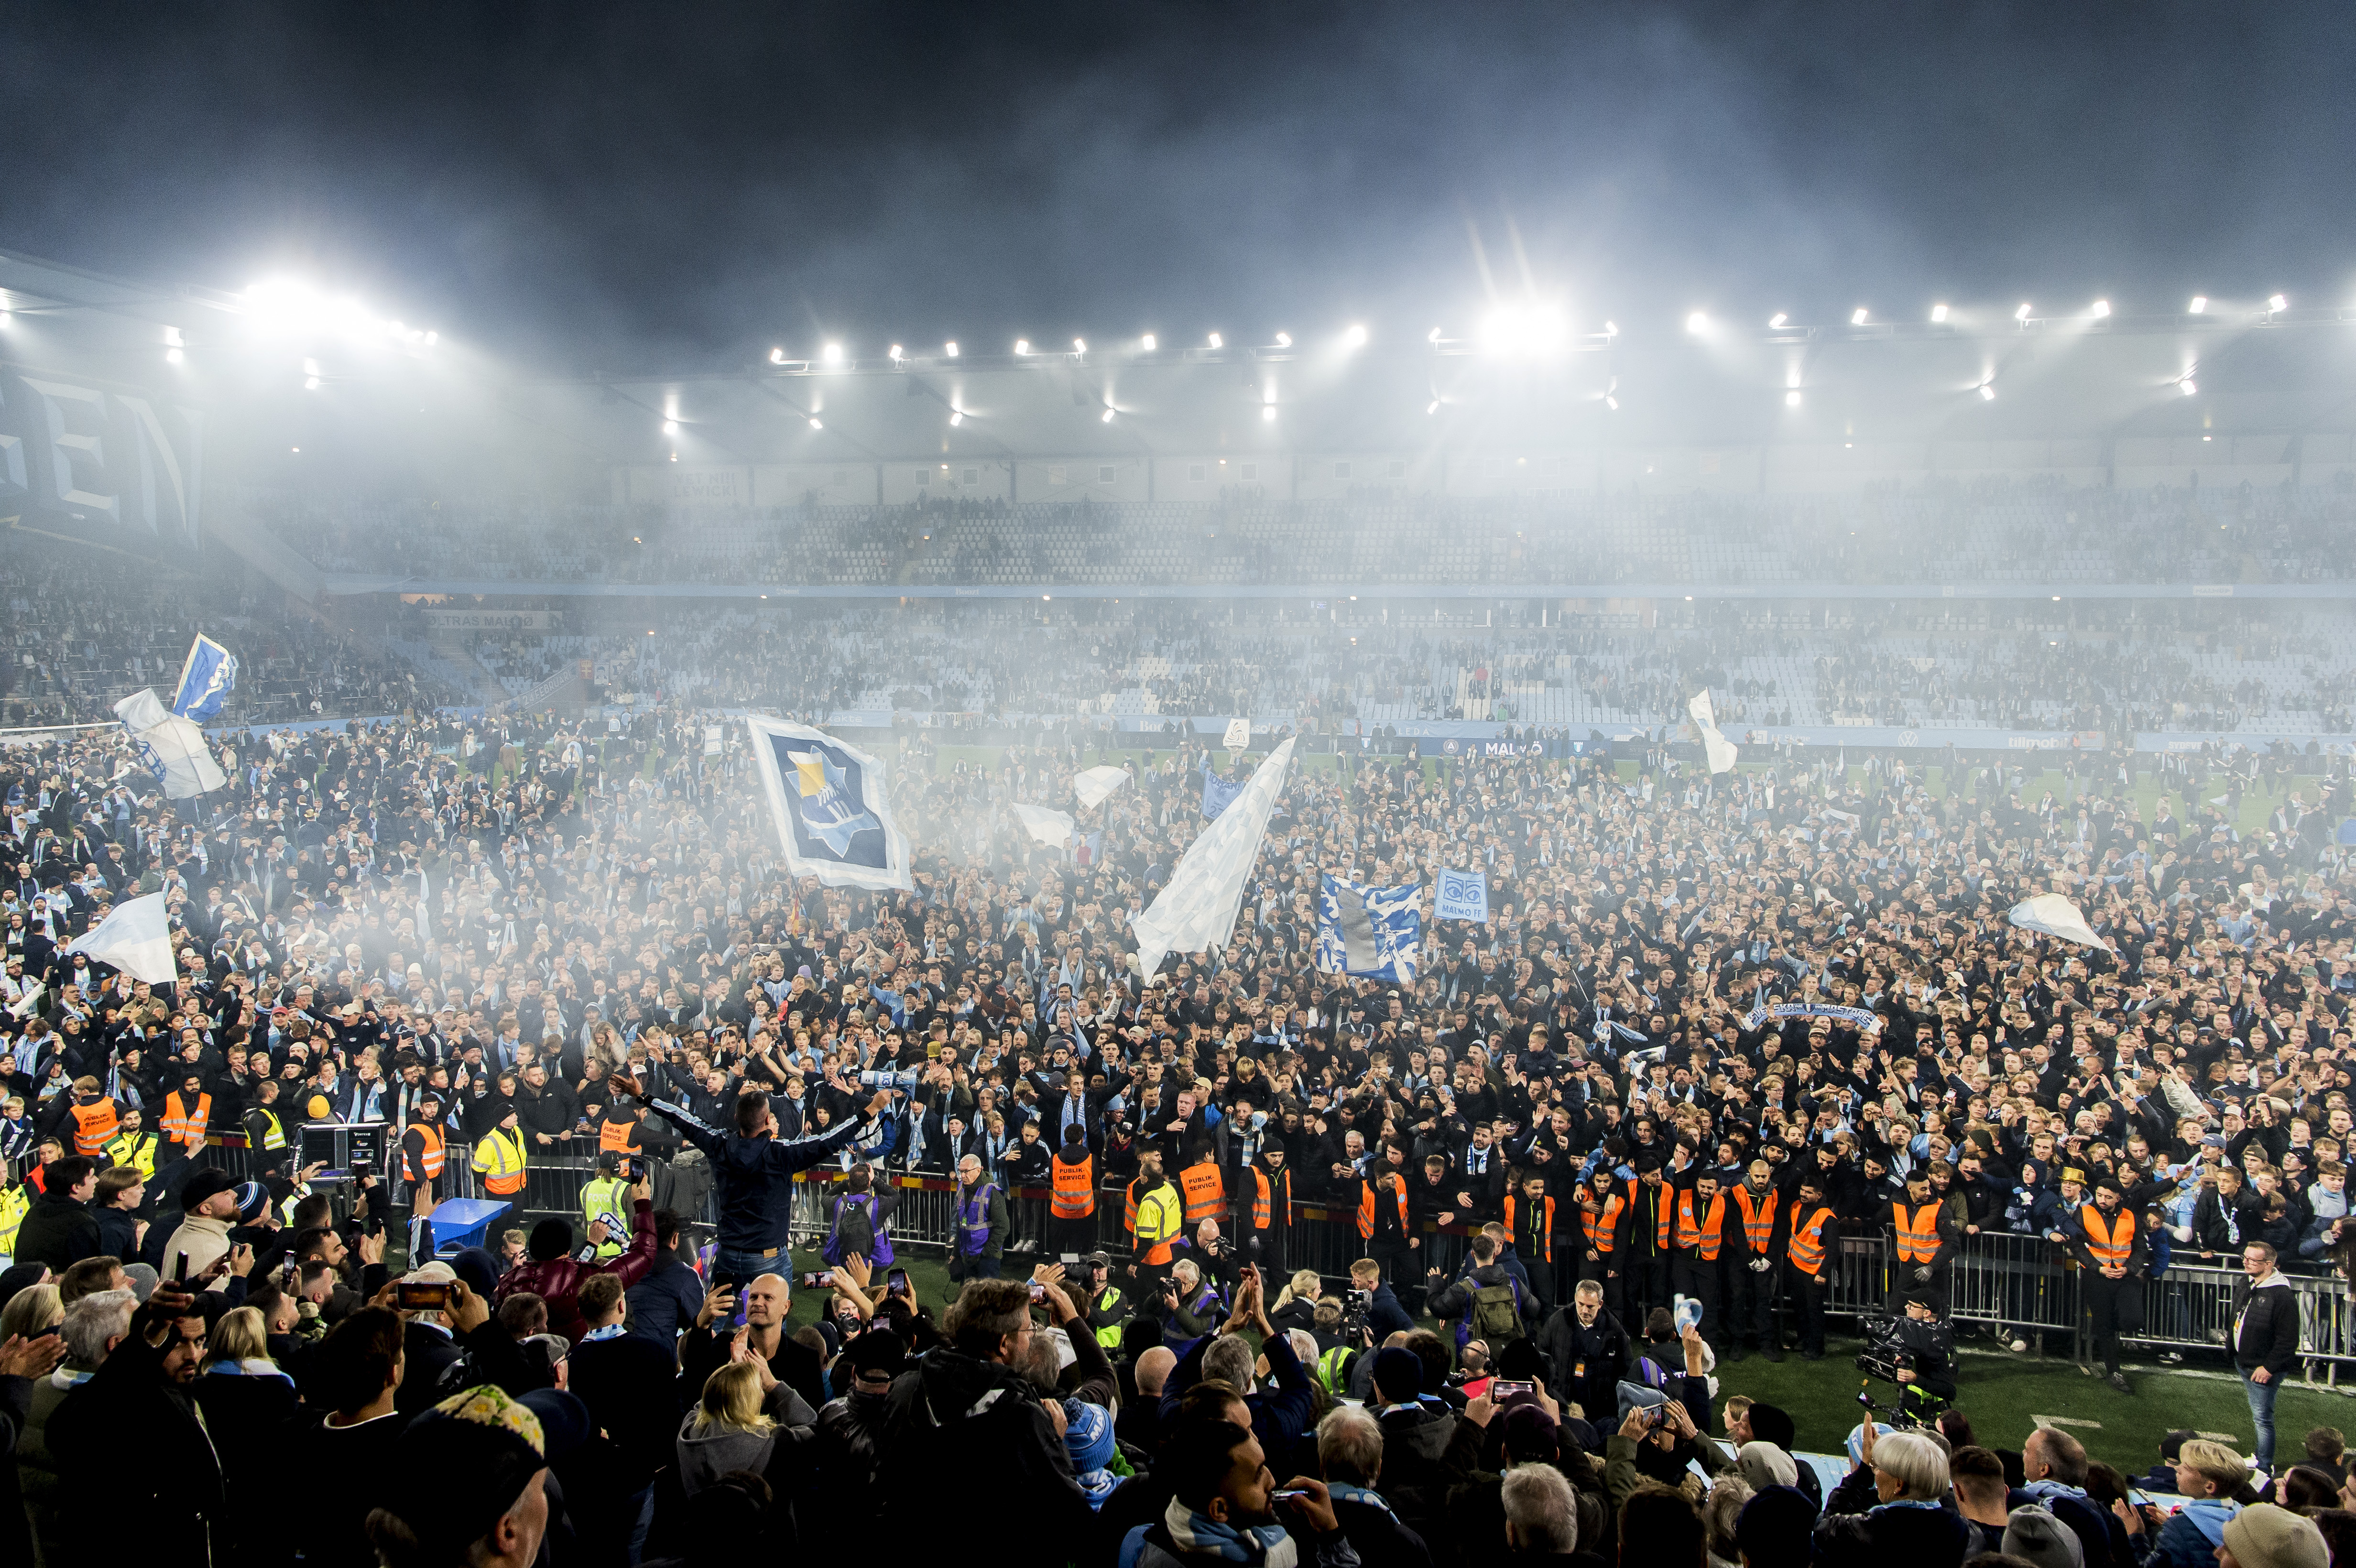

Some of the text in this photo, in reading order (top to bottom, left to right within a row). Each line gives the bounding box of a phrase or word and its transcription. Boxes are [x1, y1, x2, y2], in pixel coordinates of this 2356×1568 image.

[484, 616, 534, 627] MALØ
[1441, 904, 1482, 918] MALMÖ FF
[603, 1126, 622, 1134] PUBLIK-
[602, 1132, 622, 1141] SERVICE
[1188, 1175, 1214, 1184] PUBLIK-
[1189, 1182, 1217, 1192] SERVICE
[587, 1193, 611, 1203] FOTO
